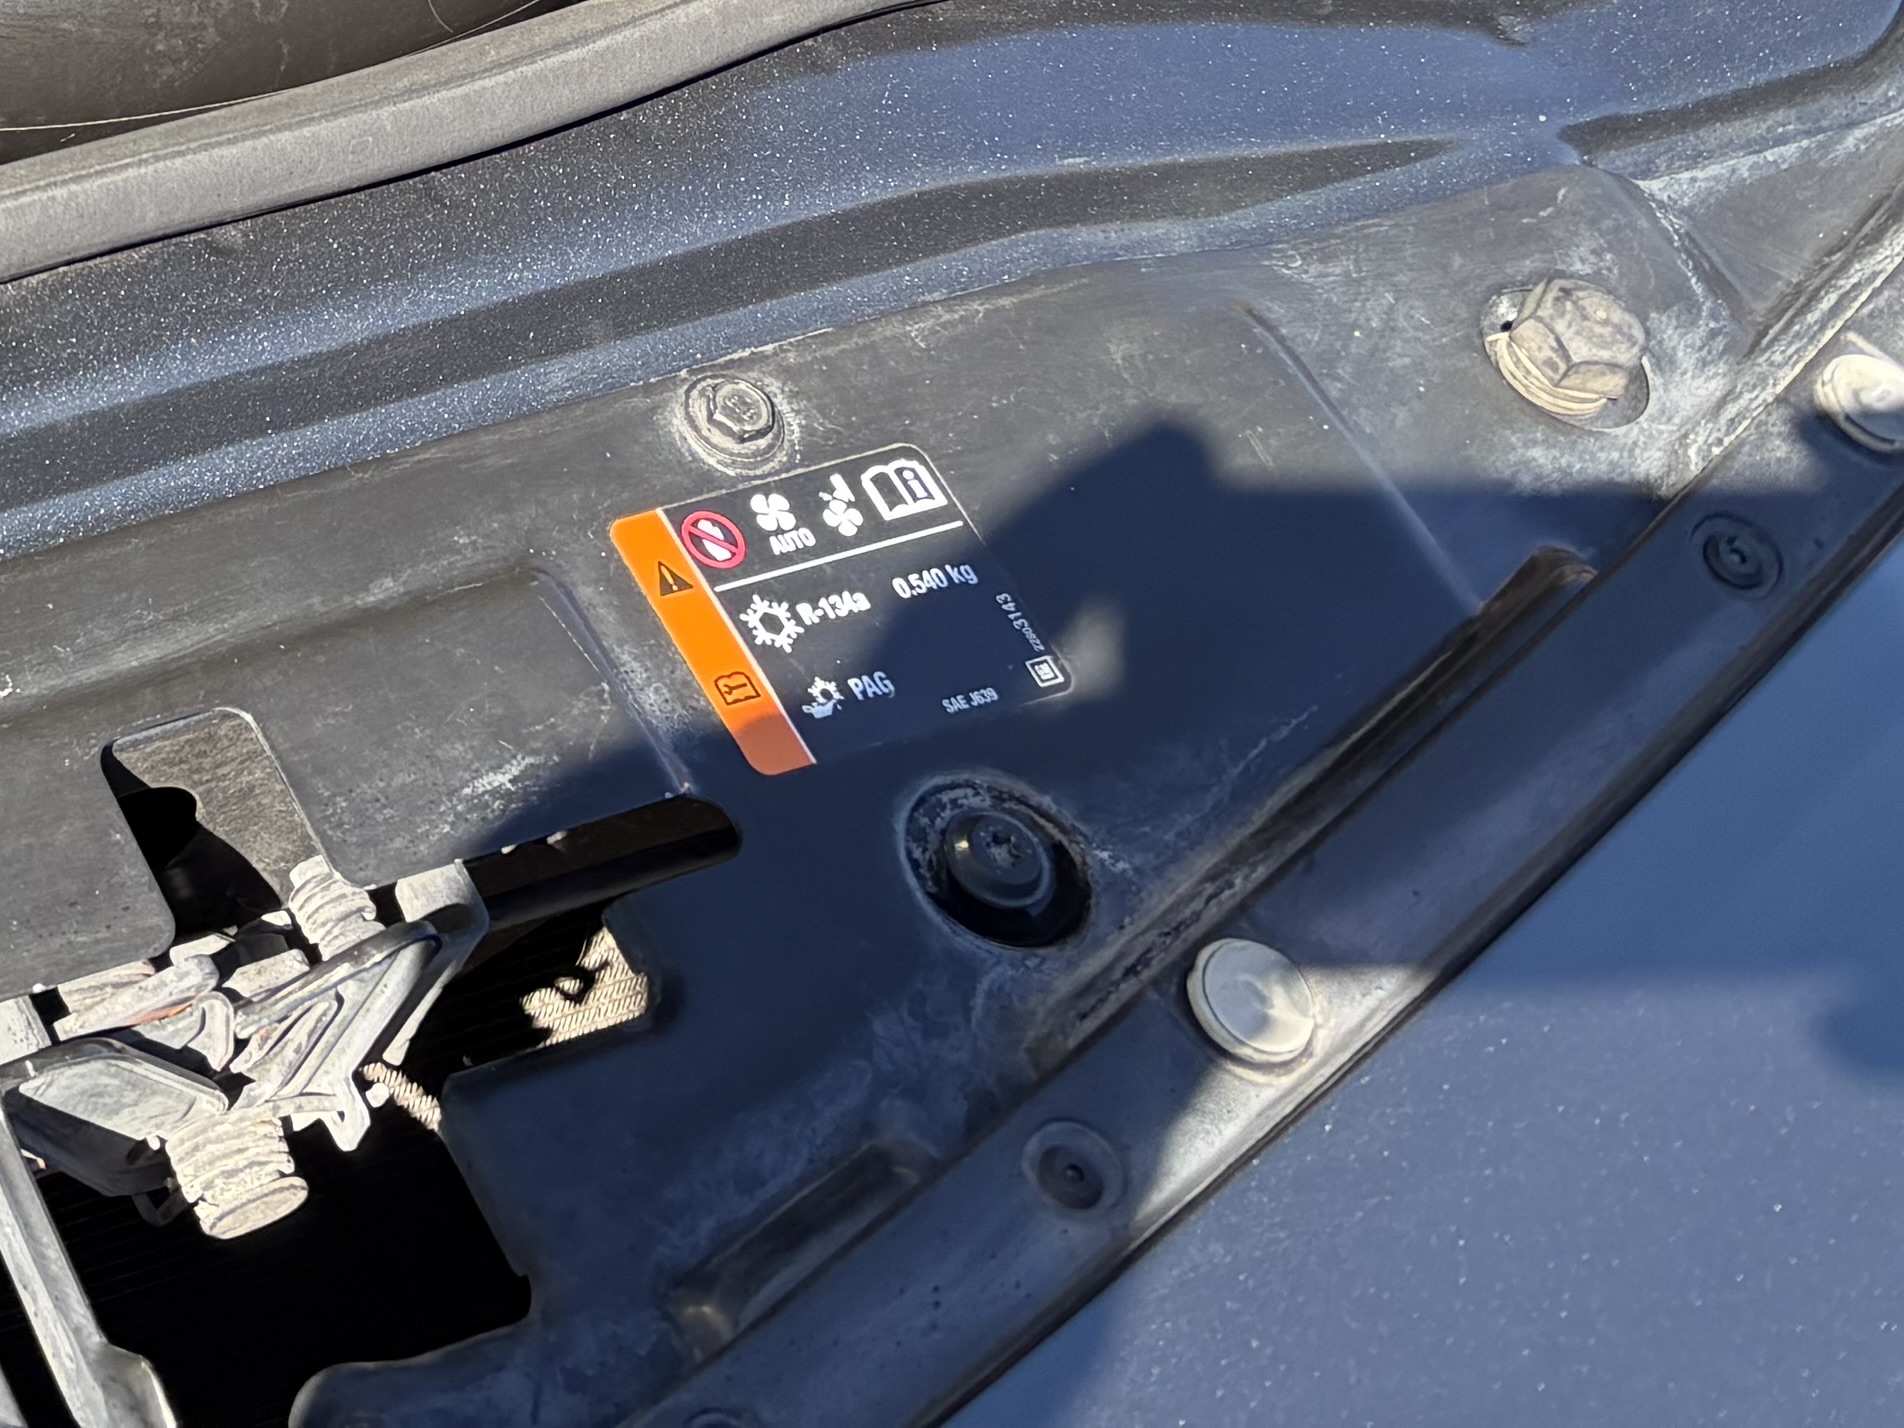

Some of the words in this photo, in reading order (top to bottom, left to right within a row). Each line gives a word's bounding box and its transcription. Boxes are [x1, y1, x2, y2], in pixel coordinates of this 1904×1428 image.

[768, 527, 816, 556] AUTO
[796, 591, 872, 626] R-134a
[892, 566, 948, 600] 0.540
[947, 562, 979, 587] kg
[847, 670, 895, 700] PAG
[942, 693, 970, 715] SAE
[969, 687, 999, 710] J639
